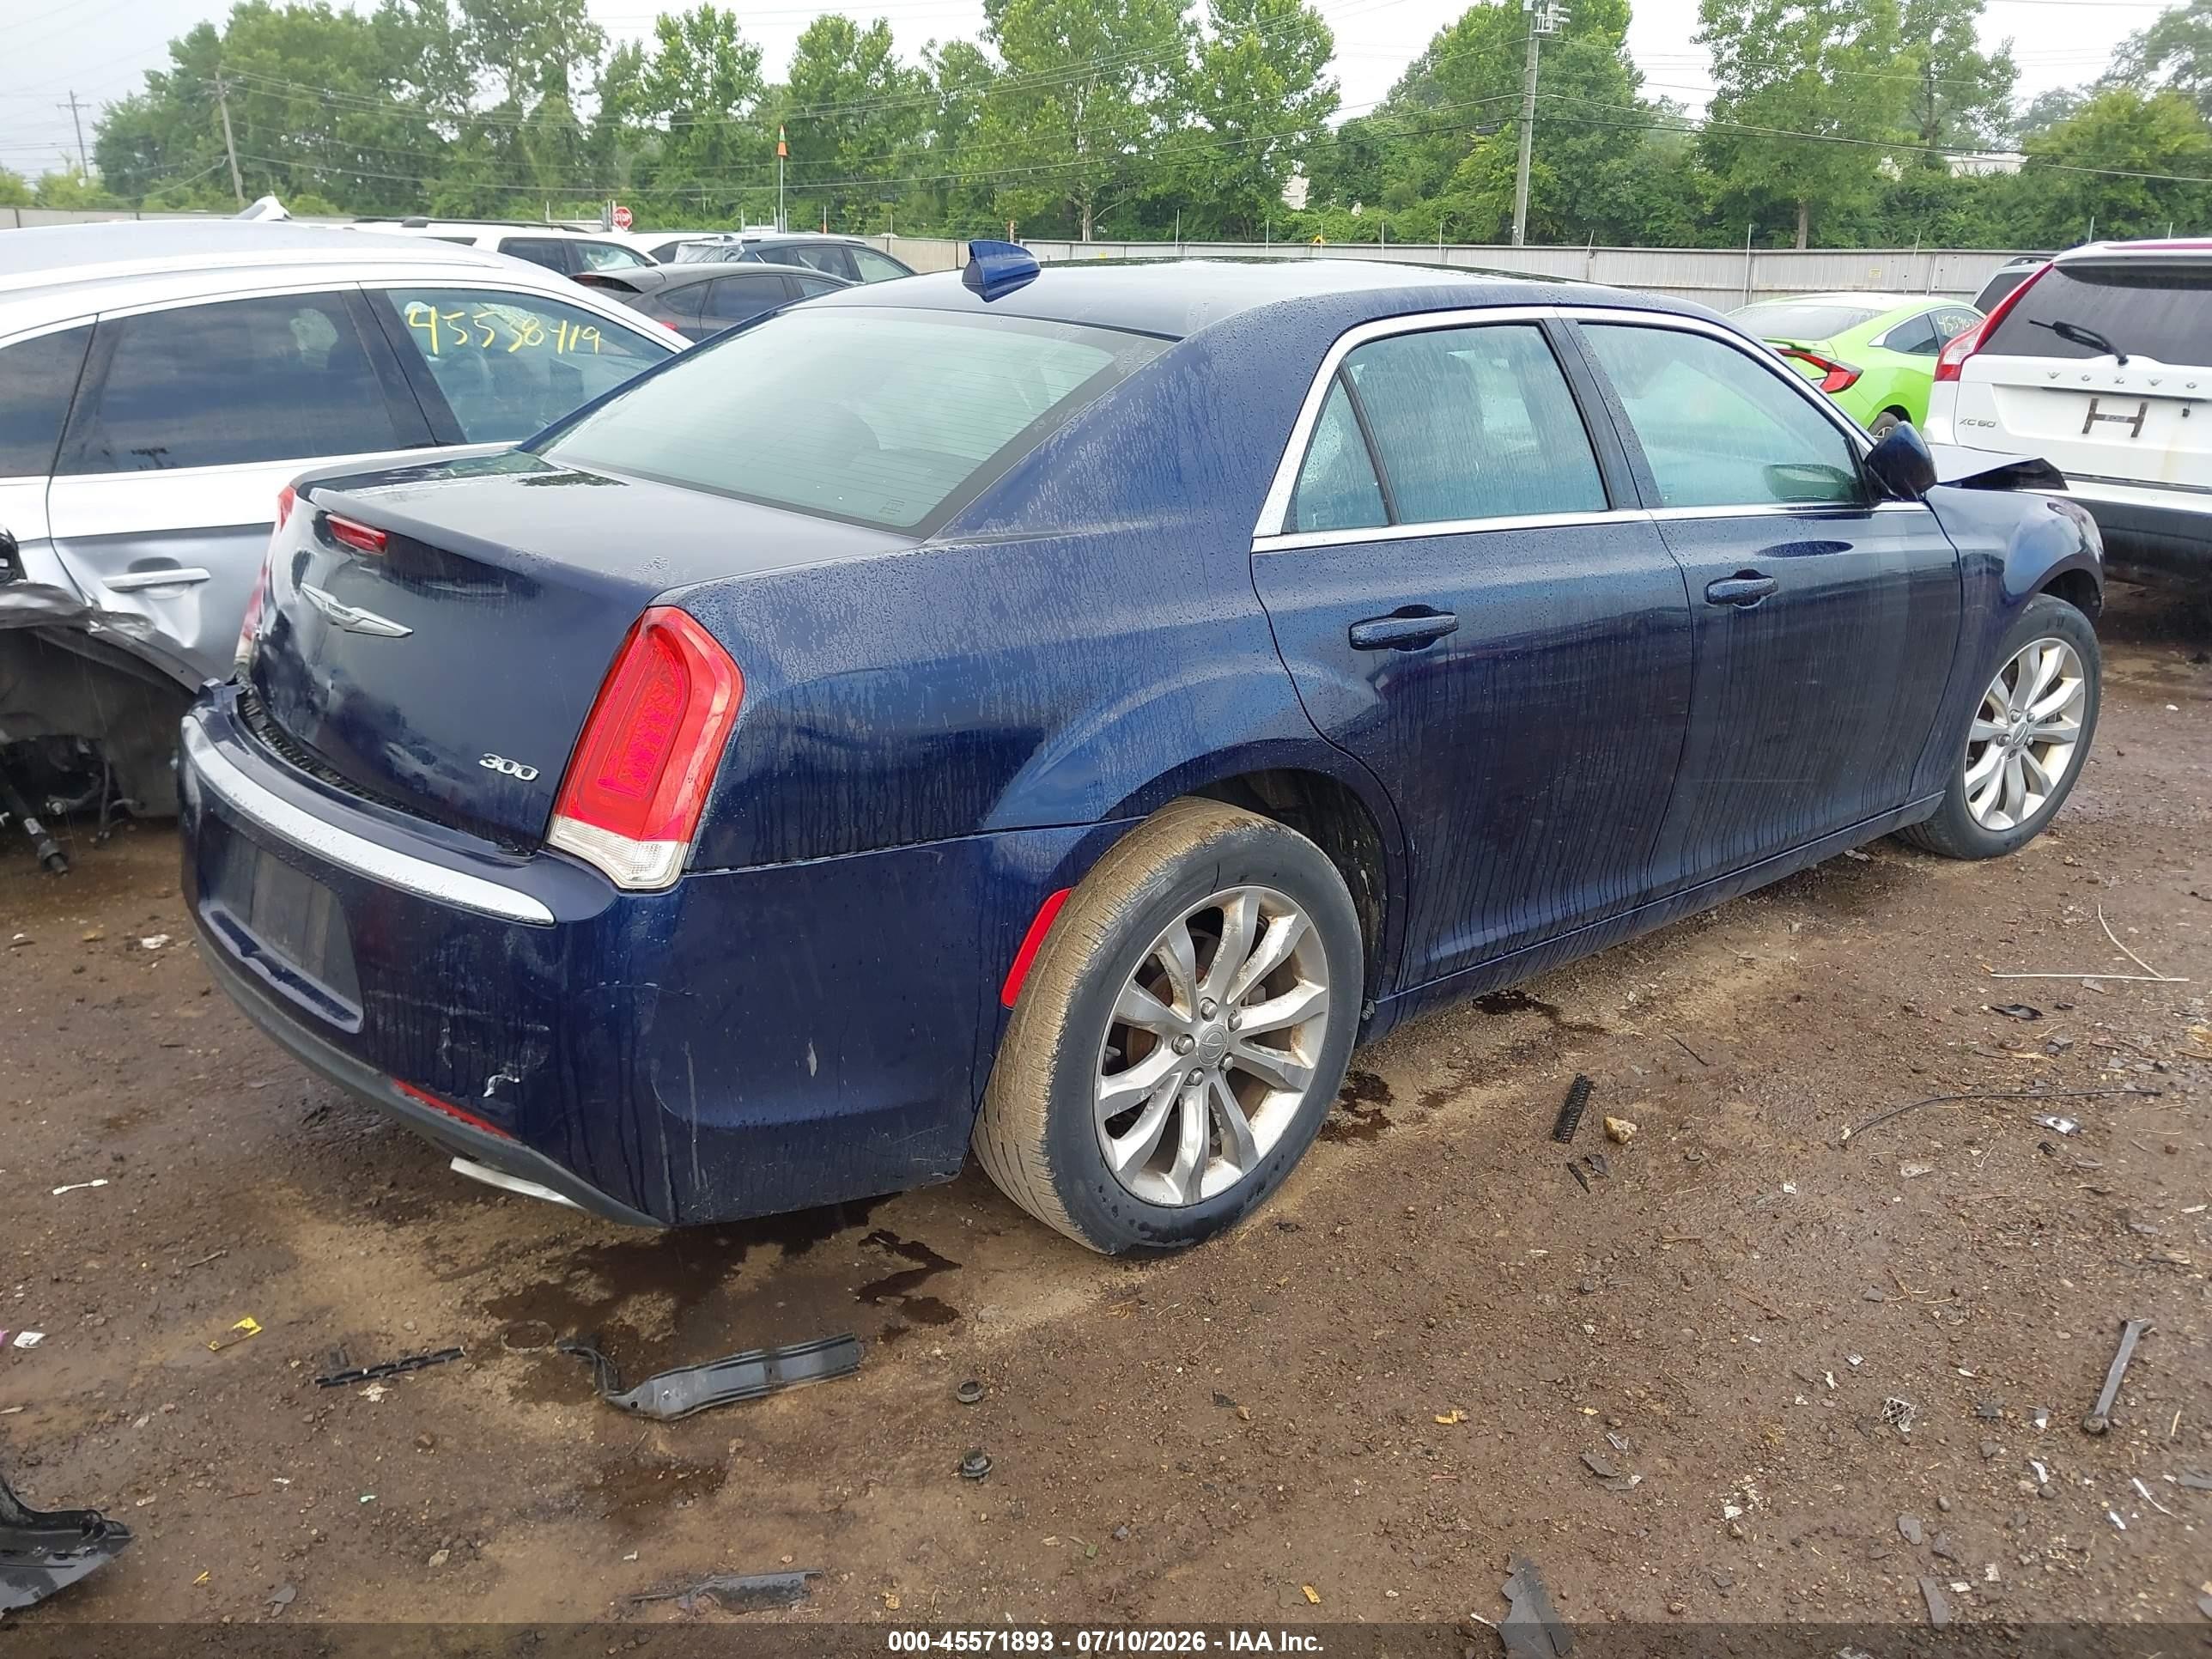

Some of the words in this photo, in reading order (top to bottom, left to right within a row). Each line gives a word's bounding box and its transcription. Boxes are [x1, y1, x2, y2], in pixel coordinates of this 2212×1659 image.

[613, 212, 631, 222] STOP
[2047, 371, 2197, 390] VOLVO
[478, 752, 539, 781] 300
